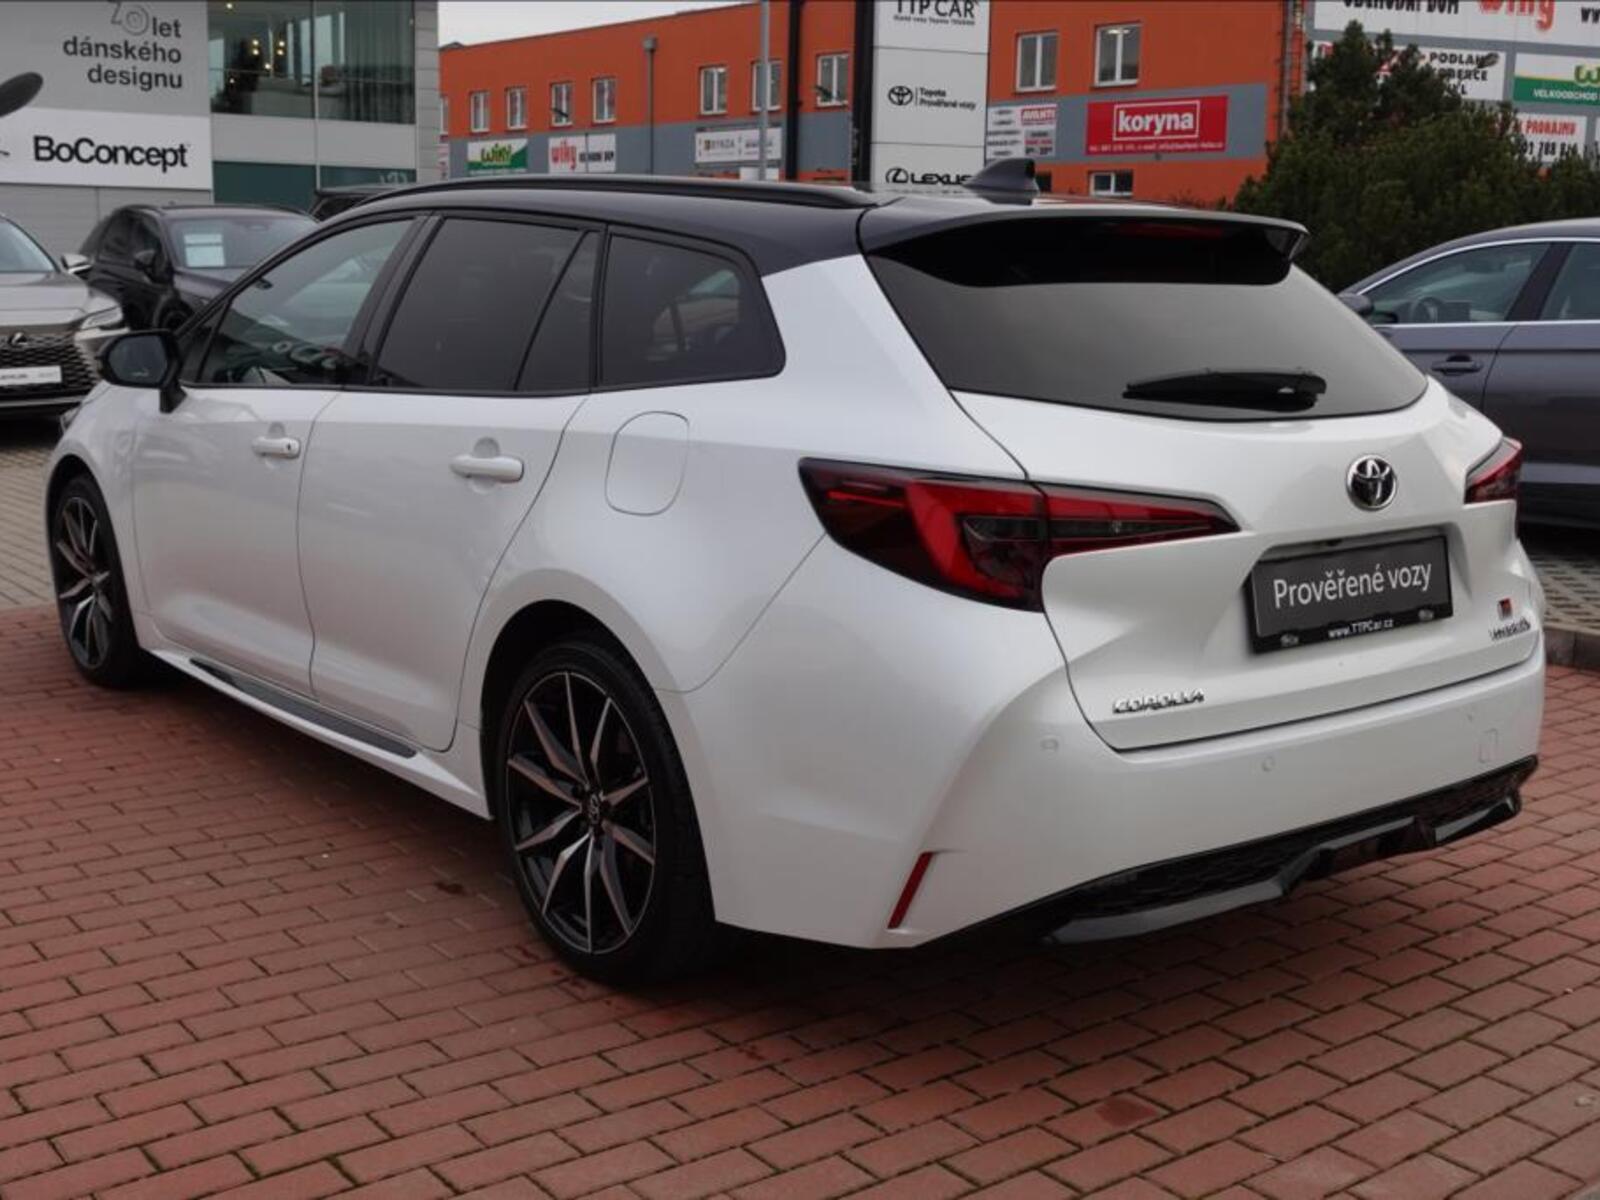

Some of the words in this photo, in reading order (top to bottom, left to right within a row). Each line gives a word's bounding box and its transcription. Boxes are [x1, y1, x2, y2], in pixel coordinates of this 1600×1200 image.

[934, 0, 975, 18] CAR
[152, 17, 182, 38] let
[63, 36, 182, 64] dánského
[87, 64, 183, 92] designu
[920, 87, 946, 98] Toyota
[1118, 110, 1195, 135] koryna
[33, 135, 189, 174] BoConcept
[1273, 563, 1384, 609] Prověřené
[1387, 563, 1432, 592] vozy
[1111, 690, 1205, 715] COROLLA
